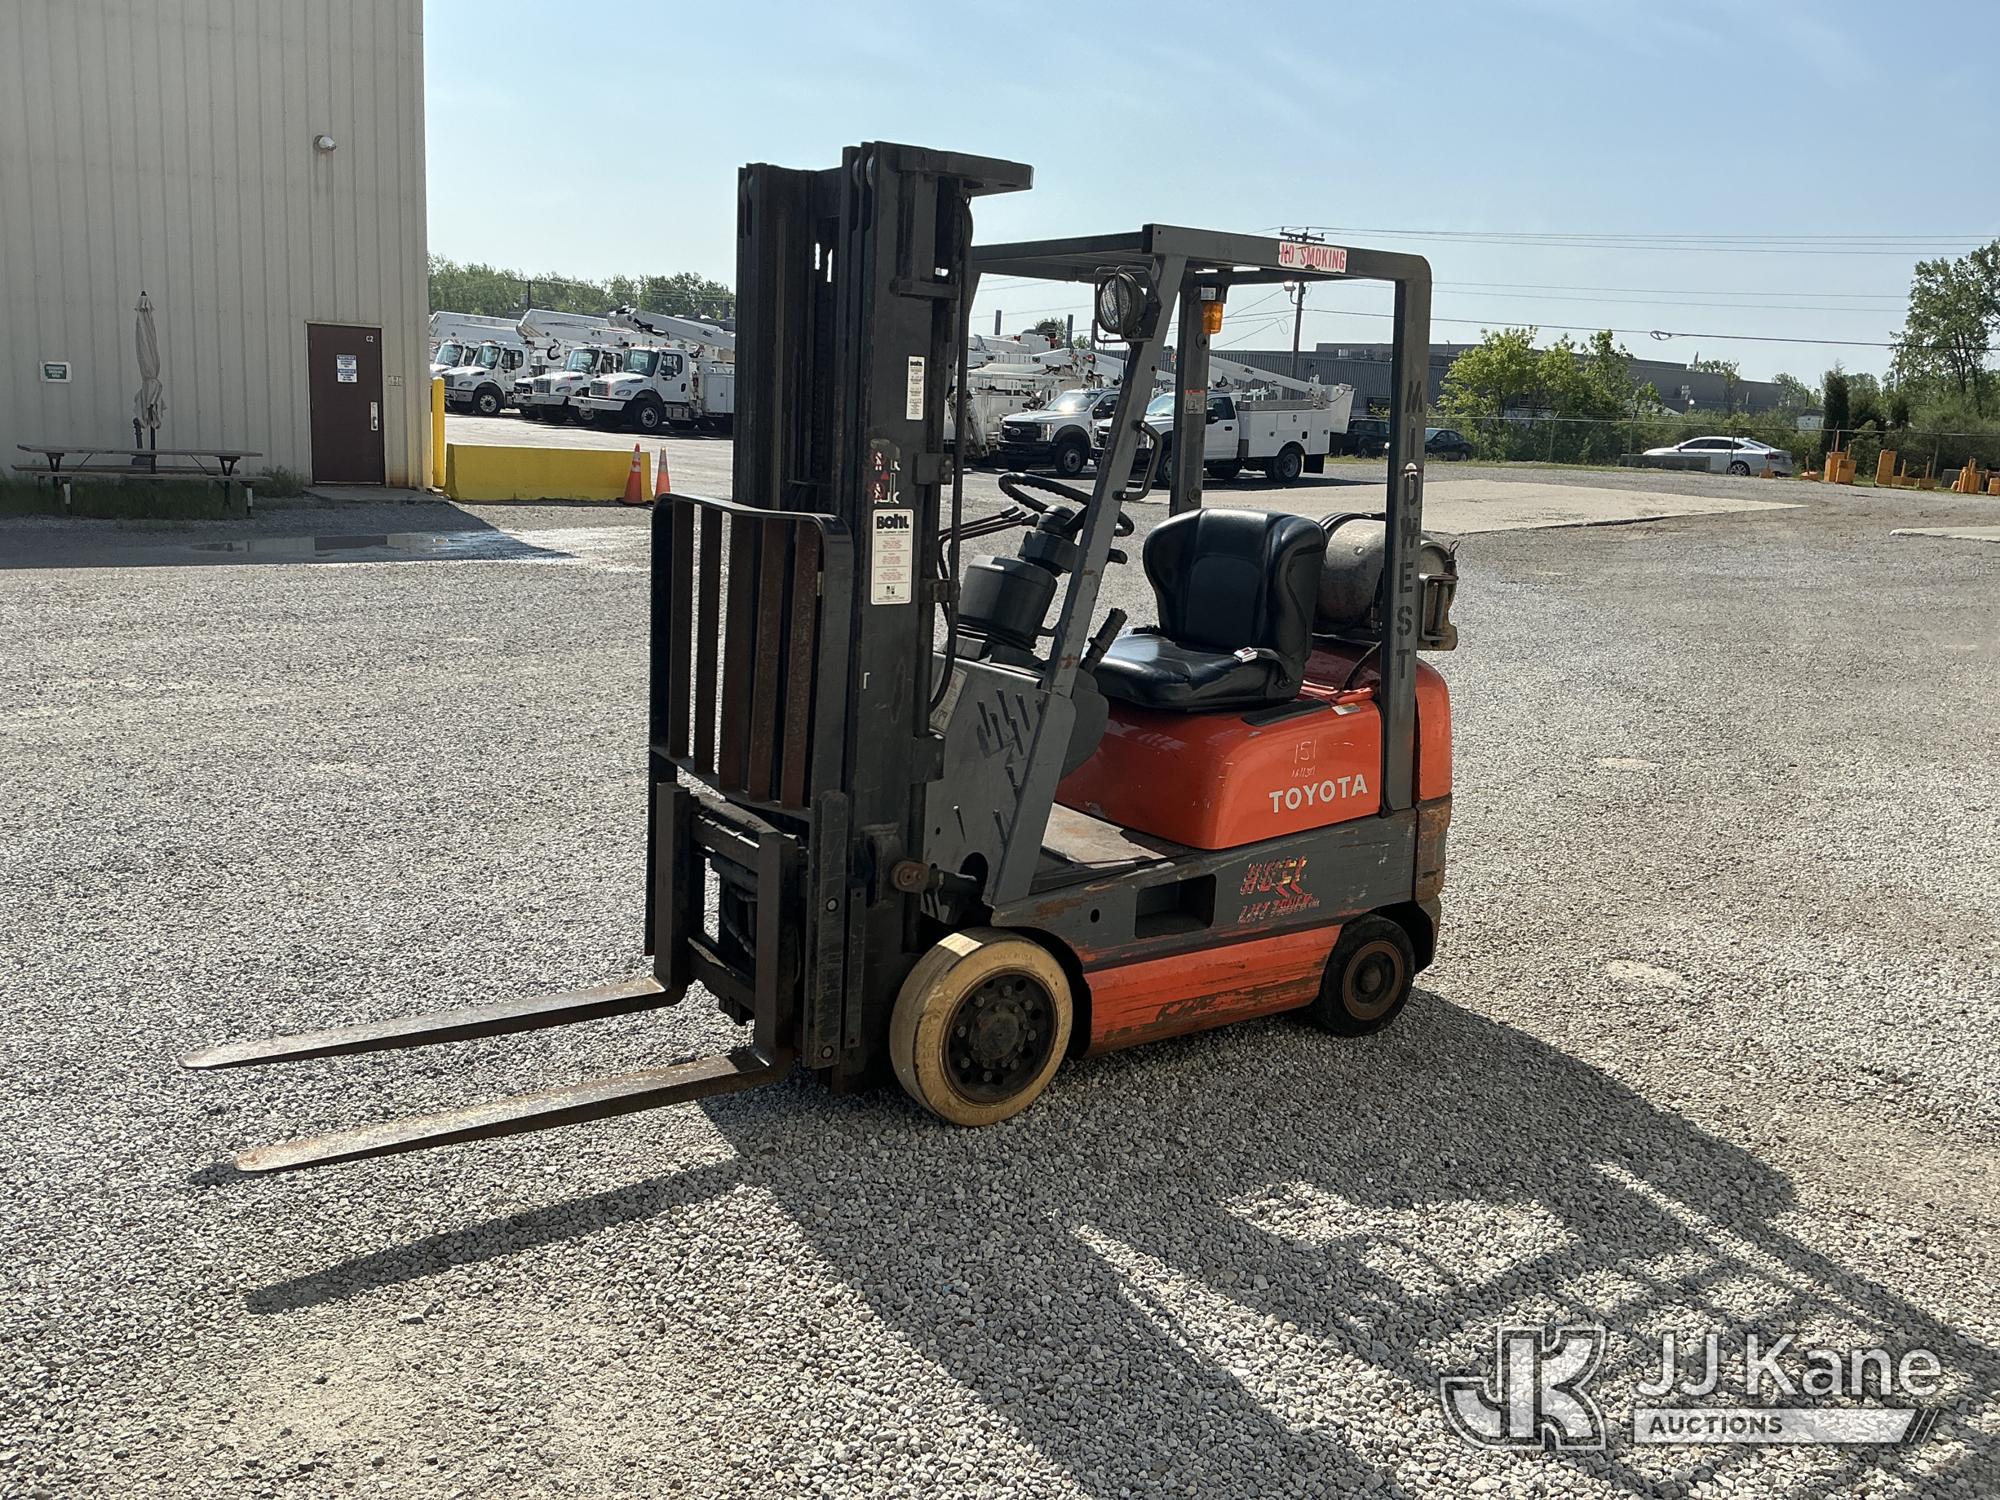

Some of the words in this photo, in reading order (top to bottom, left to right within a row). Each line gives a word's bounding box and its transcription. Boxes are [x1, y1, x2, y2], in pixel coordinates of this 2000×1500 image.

[1280, 243, 1295, 264] NO
[1300, 247, 1346, 270] SMOKING
[1396, 380, 1424, 679] MIDWEST
[1268, 774, 1369, 813] TOYOTA
